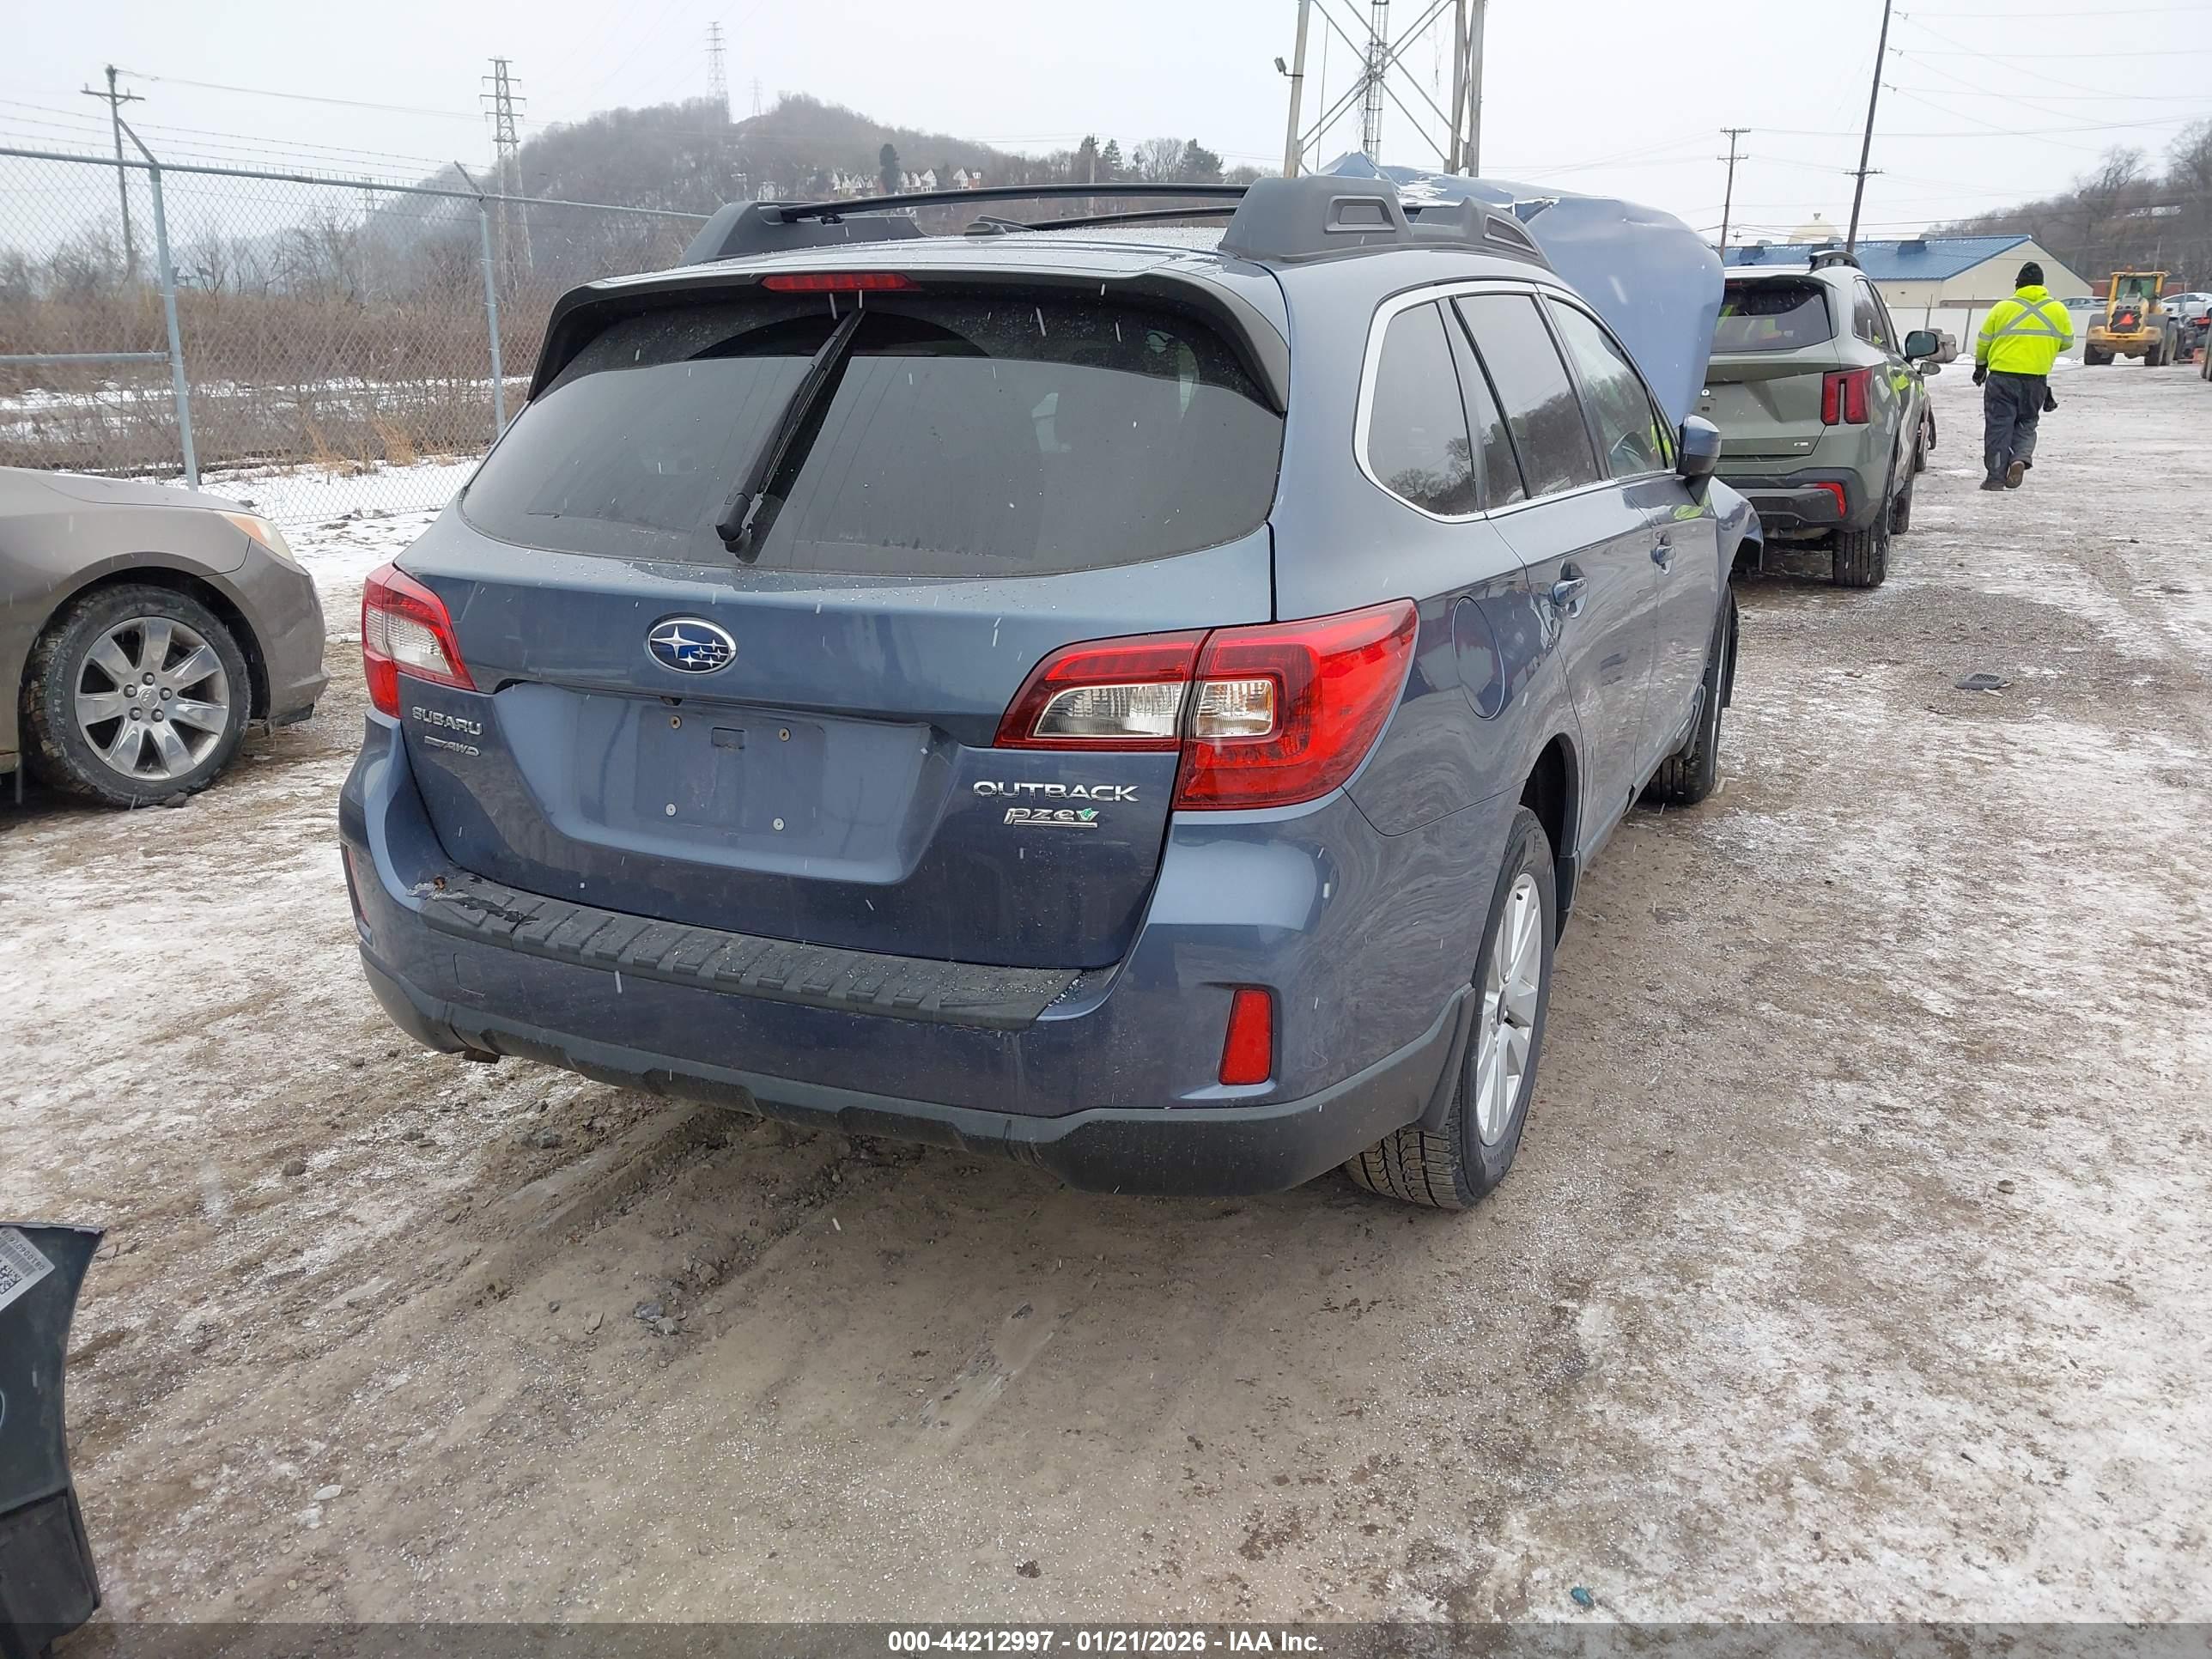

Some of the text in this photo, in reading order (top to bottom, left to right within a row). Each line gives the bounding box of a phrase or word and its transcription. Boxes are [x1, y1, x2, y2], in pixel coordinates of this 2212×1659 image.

[412, 706, 483, 736] SUBARU
[443, 741, 480, 757] AWD
[972, 781, 1140, 802] OUTBACK
